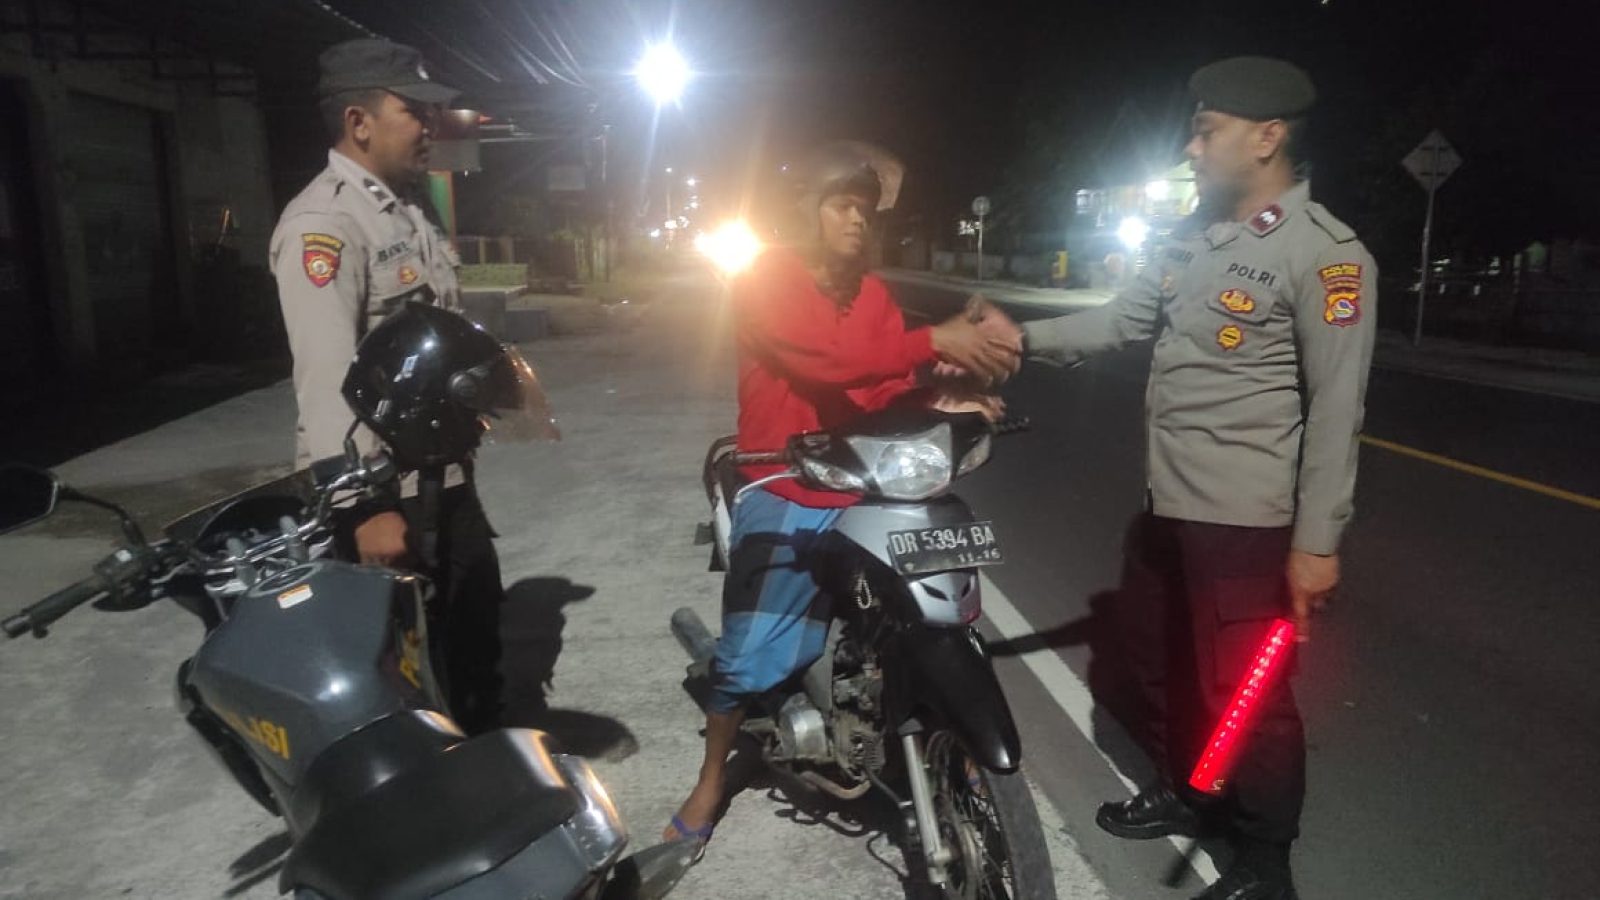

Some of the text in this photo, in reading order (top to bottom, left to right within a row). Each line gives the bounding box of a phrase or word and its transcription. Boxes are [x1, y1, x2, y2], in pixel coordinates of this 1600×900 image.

[1226, 262, 1277, 287] POLRI
[890, 525, 996, 555] DR 5394 BA
